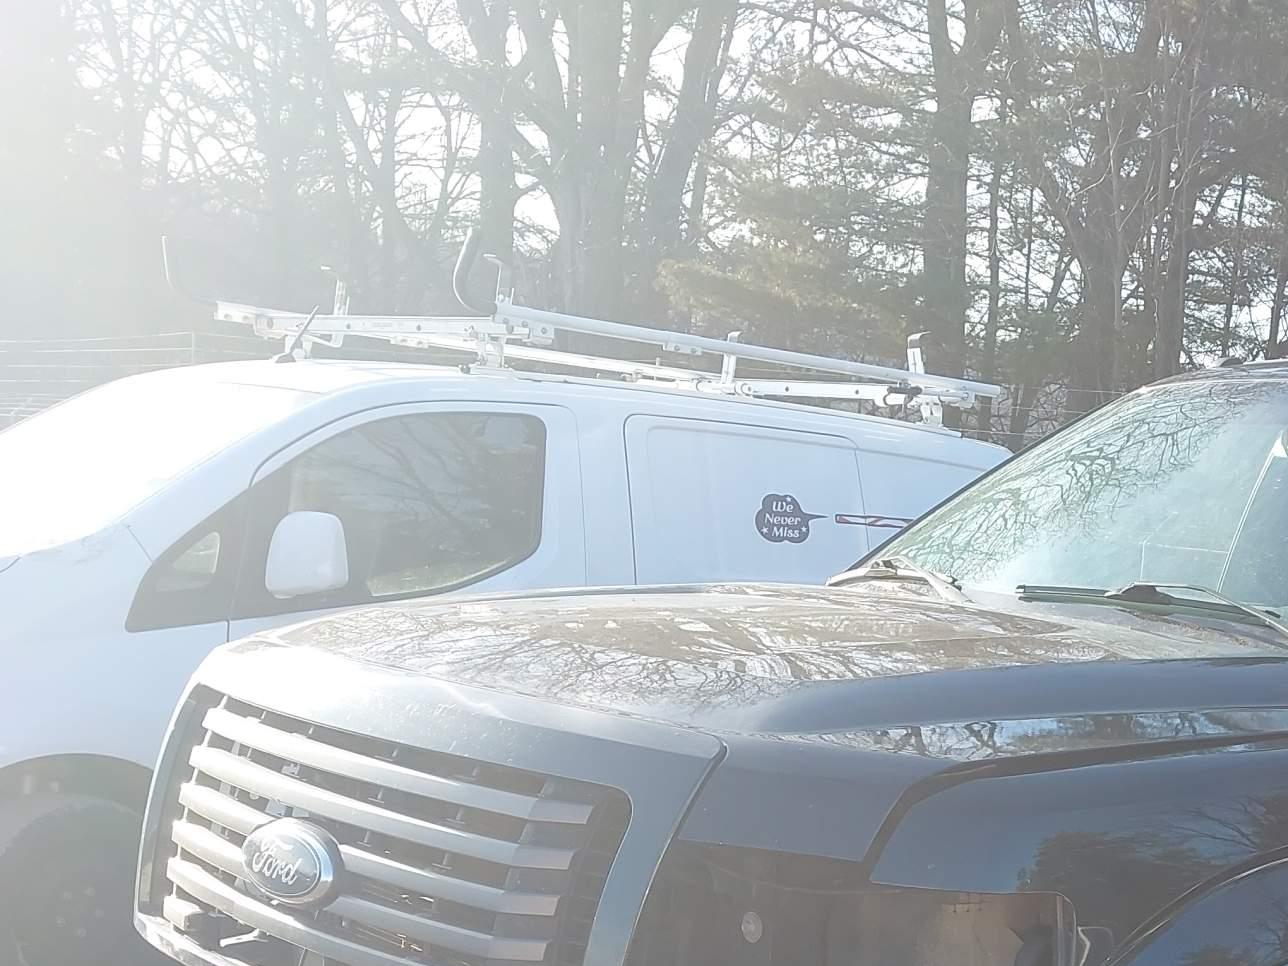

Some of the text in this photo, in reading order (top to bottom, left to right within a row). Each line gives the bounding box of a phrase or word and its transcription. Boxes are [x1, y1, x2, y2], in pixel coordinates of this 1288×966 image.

[772, 501, 794, 513] We
[764, 513, 801, 525] Never
[771, 527, 800, 538] Miss
[252, 837, 303, 886] Ford
